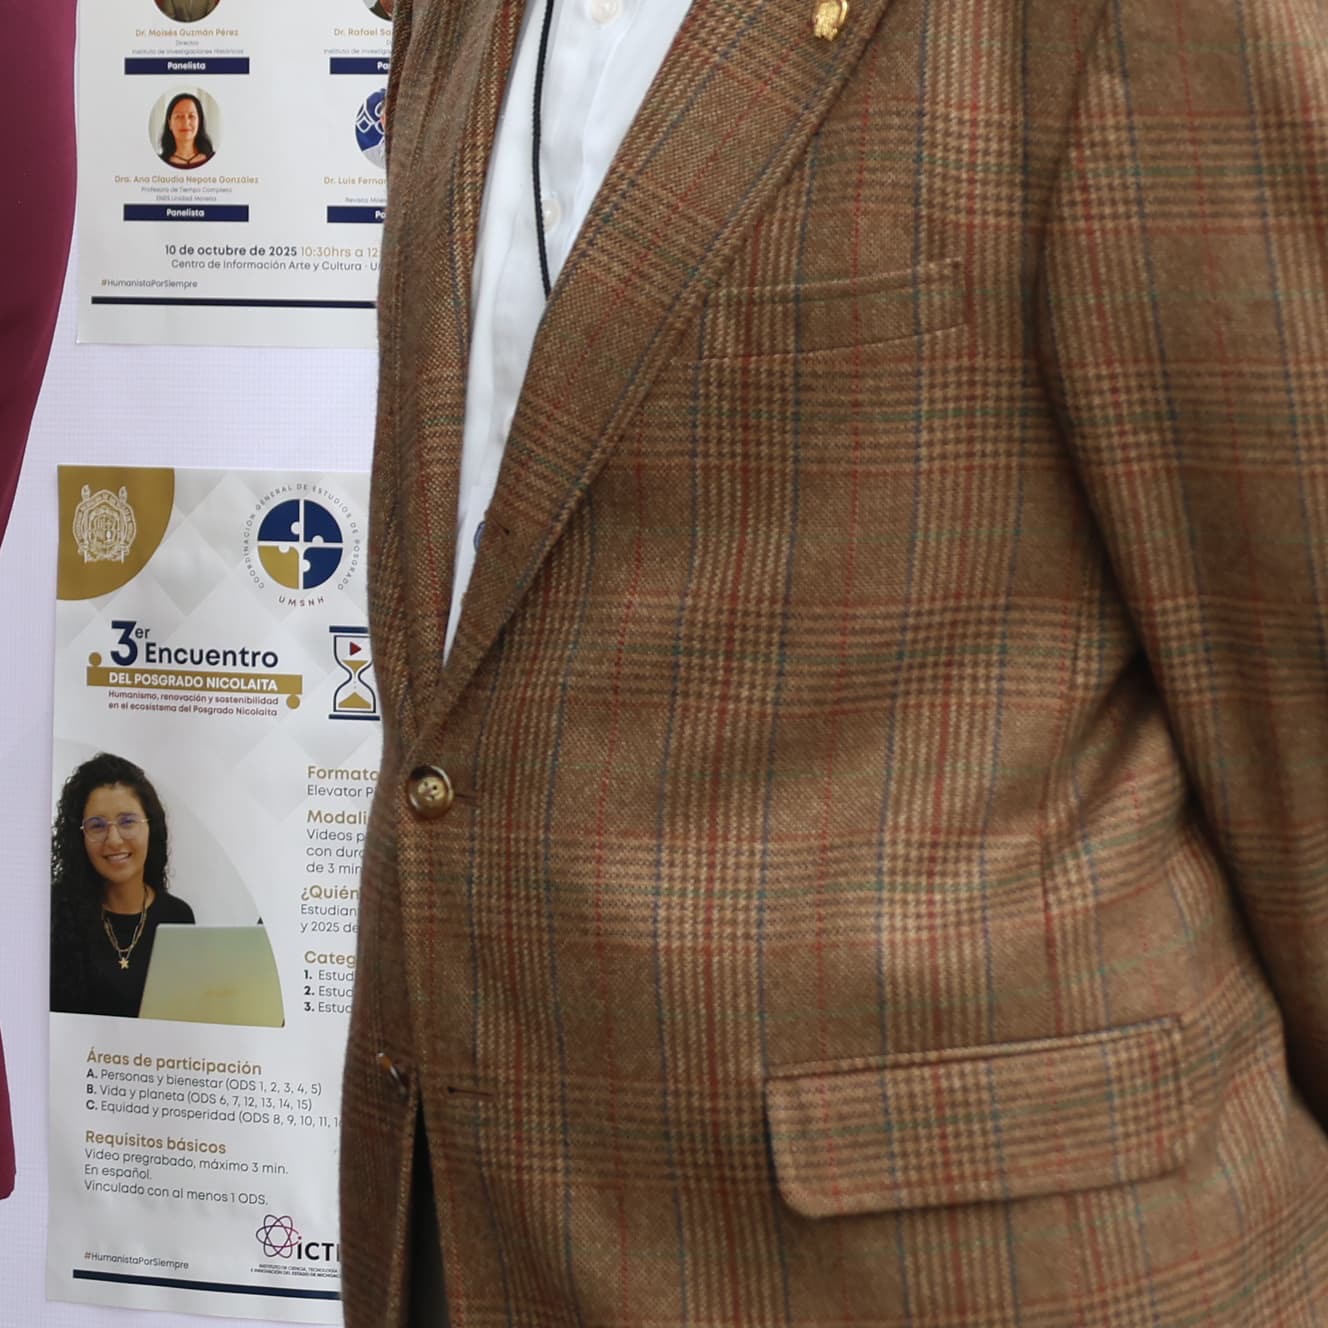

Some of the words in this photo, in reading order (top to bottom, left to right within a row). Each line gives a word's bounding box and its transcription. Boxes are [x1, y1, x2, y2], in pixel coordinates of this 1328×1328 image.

[167, 61, 206, 71] Panelista
[165, 245, 176, 256] 10
[178, 245, 192, 256] de
[195, 245, 246, 256] octubre
[250, 245, 266, 256] de
[269, 245, 298, 256] 2025
[145, 642, 278, 668] Encuentro
[109, 672, 132, 685] DEL
[135, 674, 203, 688] POSGRADO
[206, 677, 277, 691] NICOLAITA
[87, 1047, 129, 1066] Áreas
[133, 1053, 152, 1067] de
[156, 1056, 261, 1076] participación
[86, 1130, 163, 1150] Requisitos
[167, 1137, 226, 1154] básicos
[84, 1251, 189, 1269] #HumanistaPorSiempre
